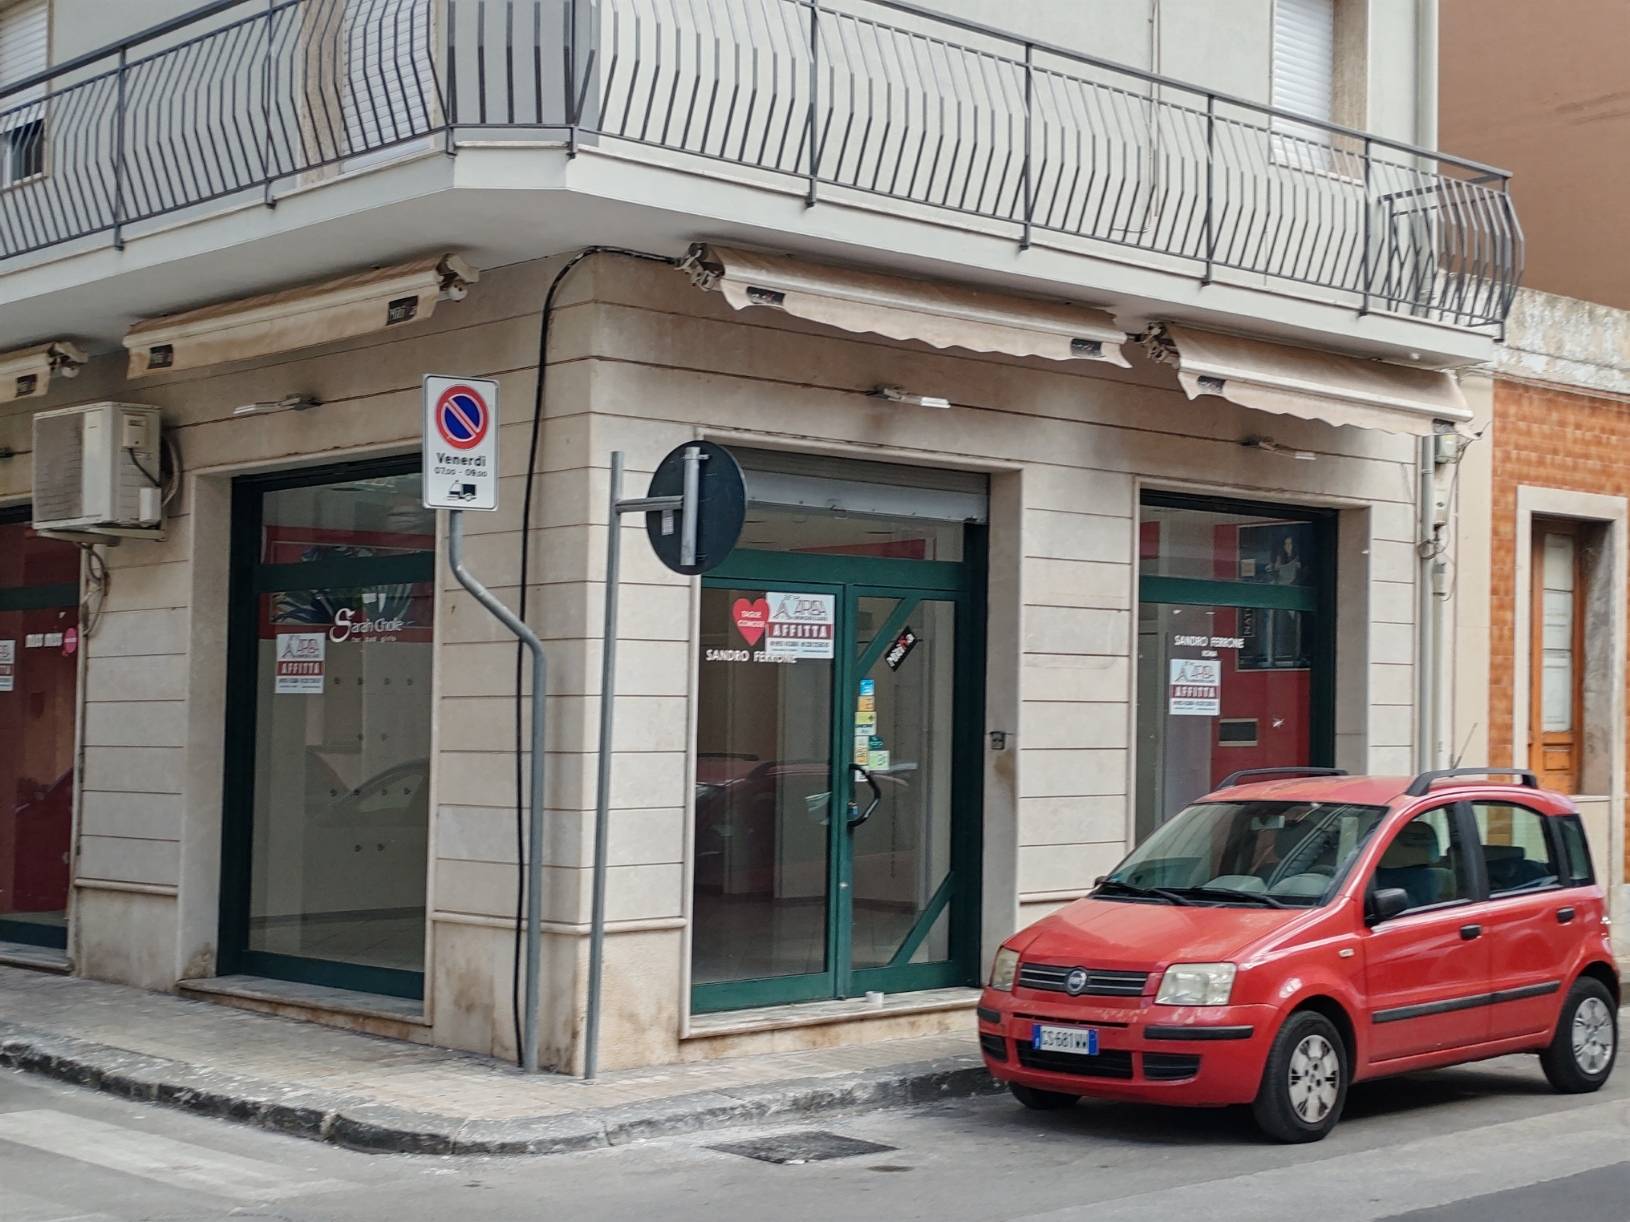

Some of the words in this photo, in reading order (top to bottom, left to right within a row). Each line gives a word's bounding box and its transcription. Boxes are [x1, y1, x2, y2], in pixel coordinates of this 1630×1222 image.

[772, 624, 828, 638] AFFITTA
[1174, 634, 1209, 647] SANDRO
[705, 648, 750, 662] SANDRO
[281, 662, 321, 674] AFFITTA
[1174, 686, 1216, 698] AFFITTA
